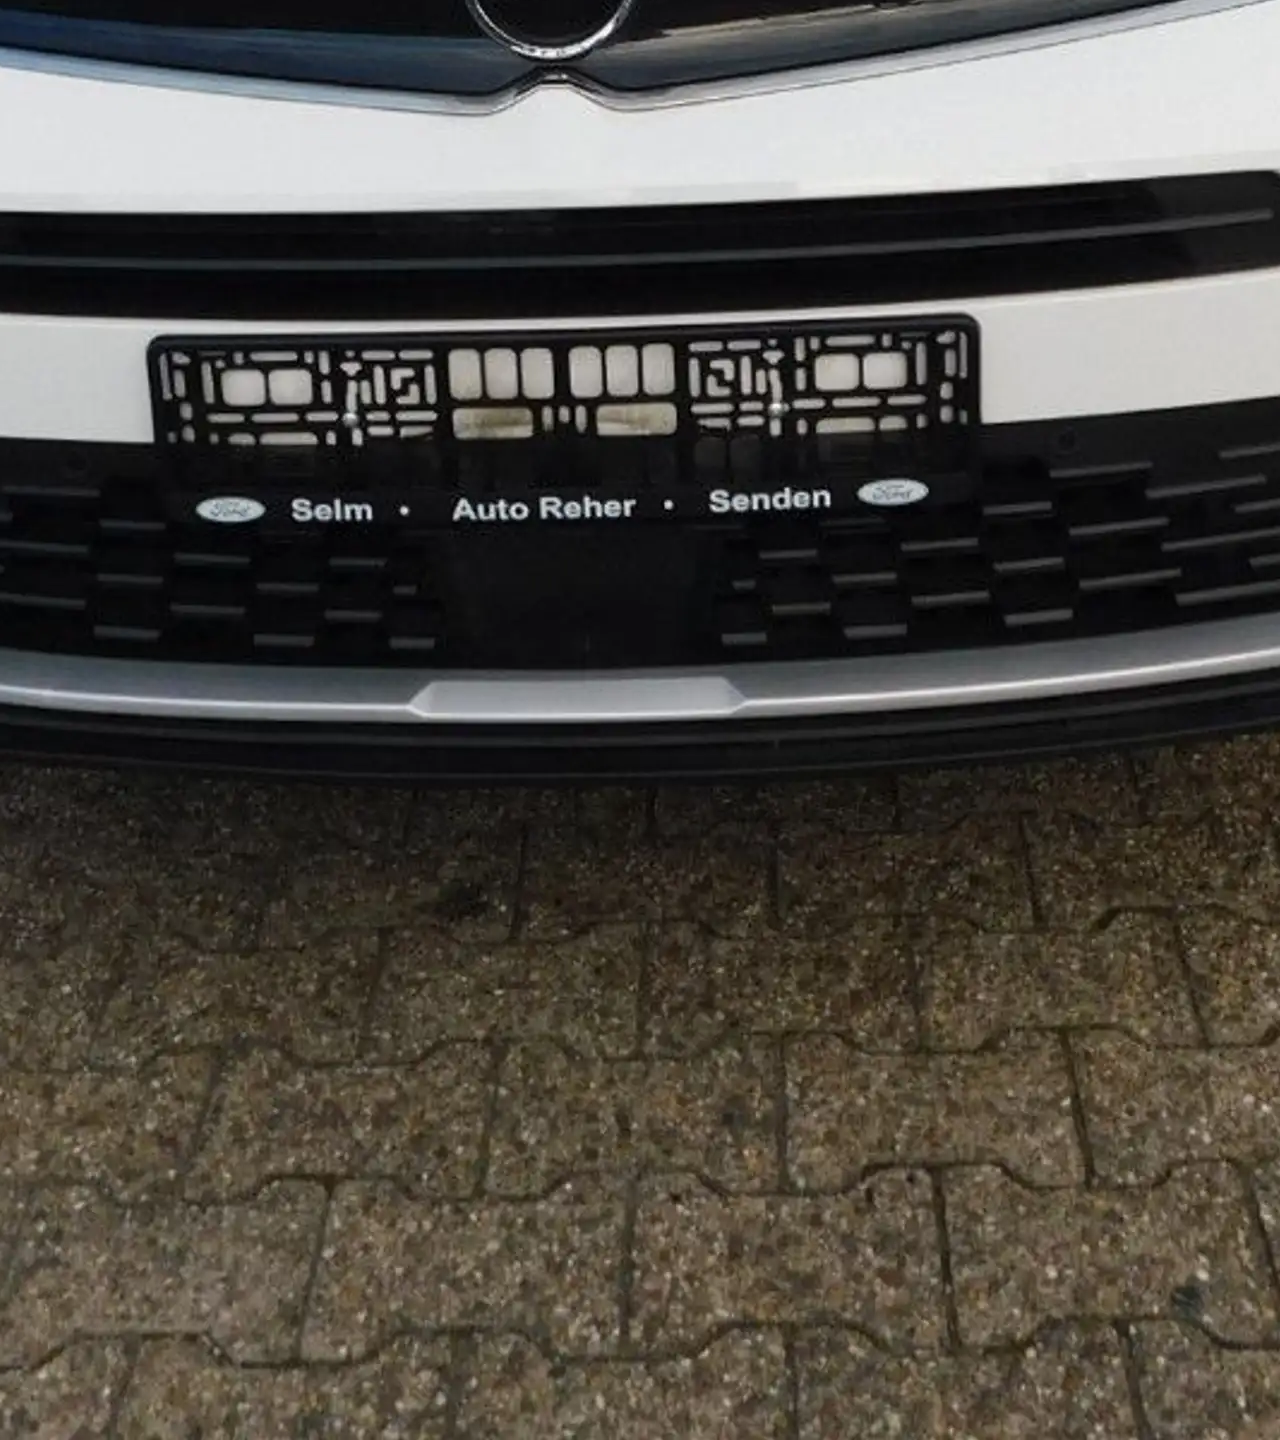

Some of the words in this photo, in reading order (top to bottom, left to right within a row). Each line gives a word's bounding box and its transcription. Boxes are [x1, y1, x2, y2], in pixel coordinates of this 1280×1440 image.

[291, 497, 373, 522] Selm
[452, 496, 529, 522] Auto
[538, 494, 636, 520] Reher
[709, 485, 832, 513] Senden
